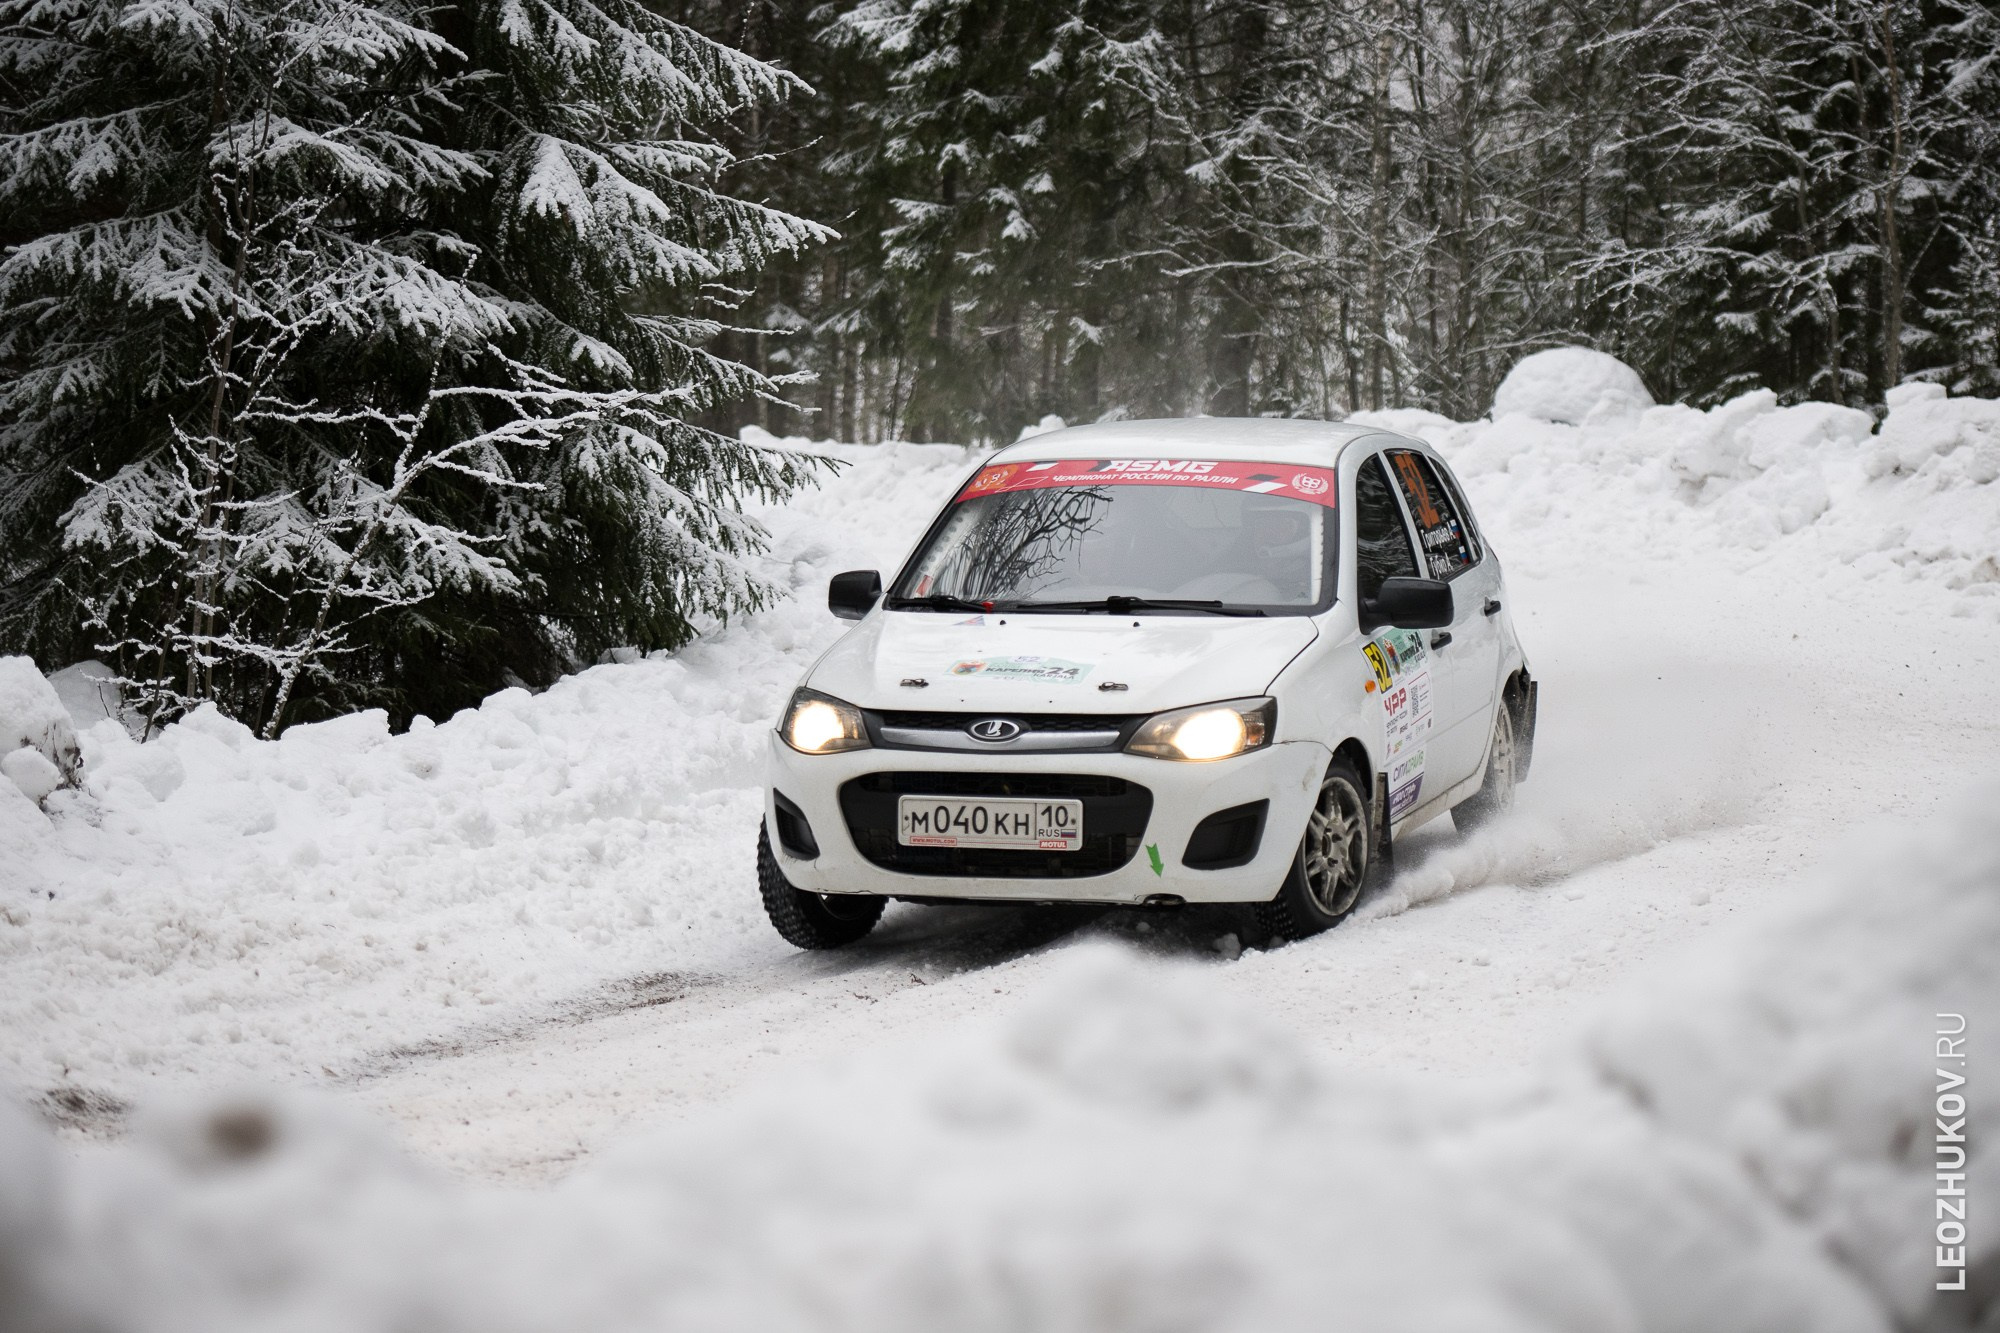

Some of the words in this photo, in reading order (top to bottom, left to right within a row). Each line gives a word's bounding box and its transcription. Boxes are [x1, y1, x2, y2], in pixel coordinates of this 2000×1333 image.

[1052, 473, 1119, 482] ЧЕМПИОНАТ
[1119, 472, 1173, 481] РОССИИ
[1191, 474, 1239, 484] РАЛЛИ
[1394, 453, 1440, 529] 52
[1363, 643, 1393, 692] 52
[1041, 805, 1069, 828] 10
[1038, 828, 1060, 838] RUS
